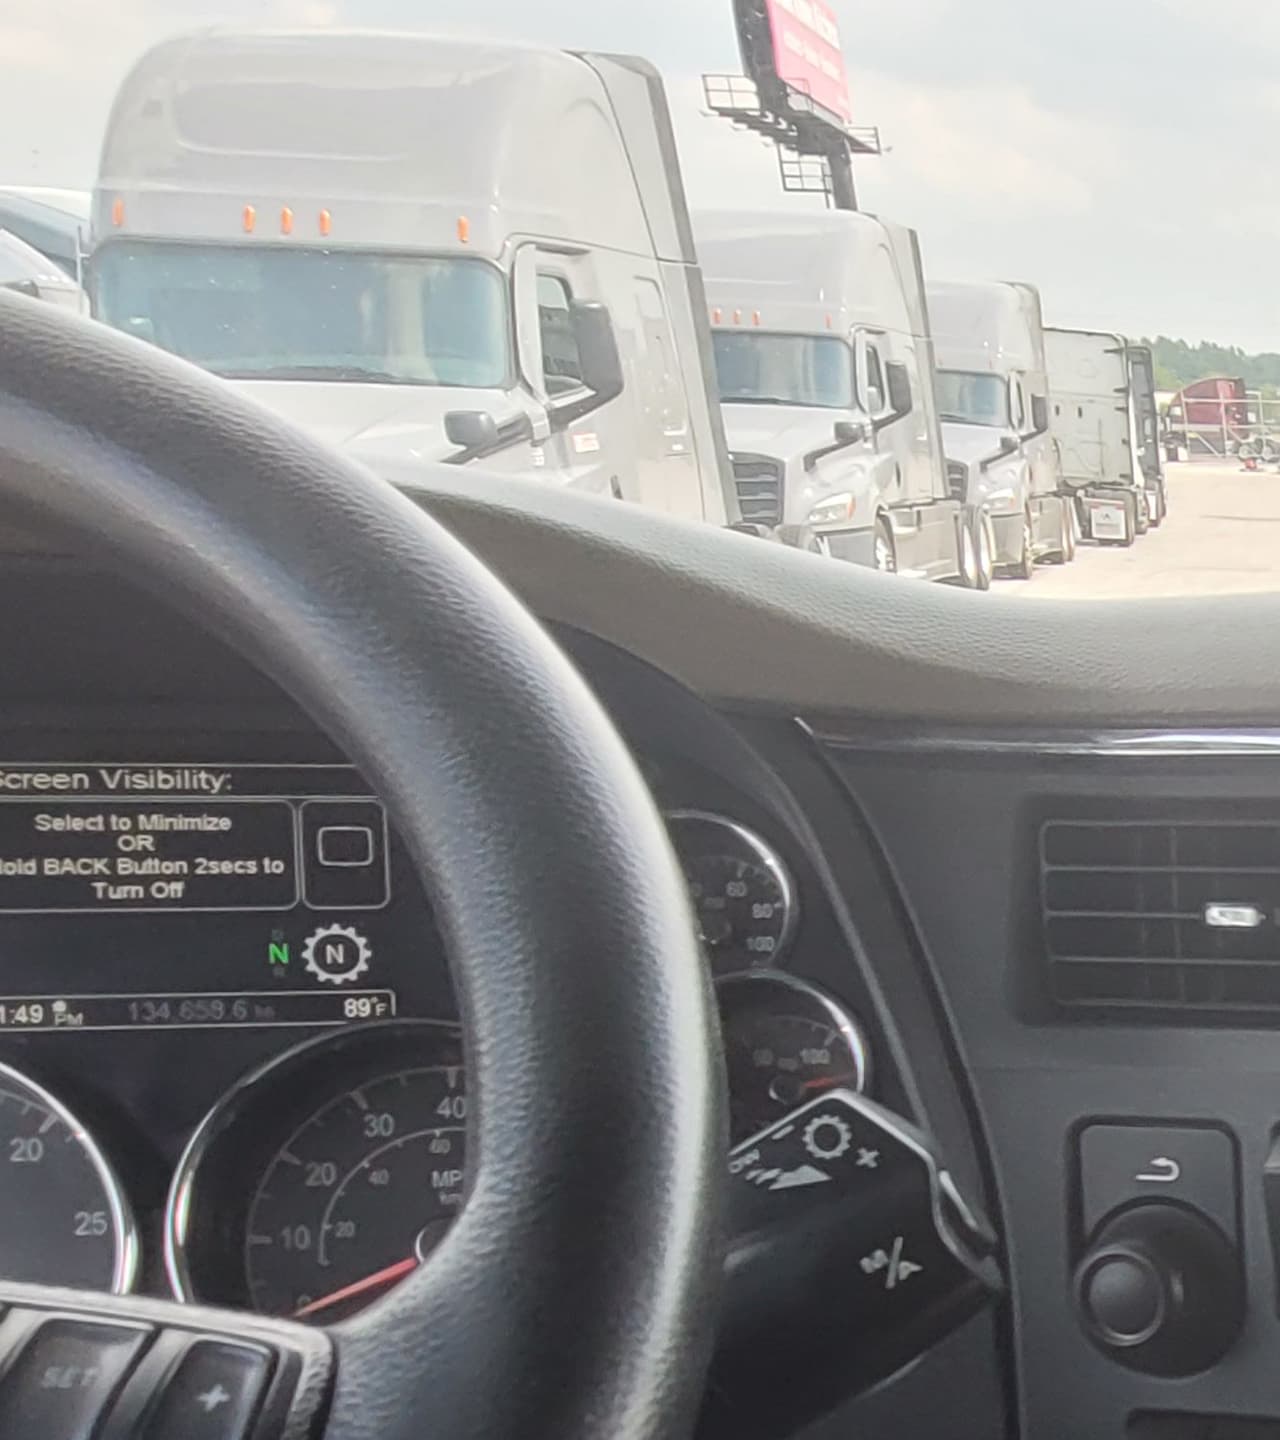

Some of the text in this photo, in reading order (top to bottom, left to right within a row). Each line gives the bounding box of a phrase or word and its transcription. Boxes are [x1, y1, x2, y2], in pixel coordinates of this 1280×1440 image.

[99, 769, 232, 794] Visibility:
[34, 814, 232, 832] Select to Minimize
[117, 834, 156, 852] OR
[0, 857, 285, 876] old BACK Button 2secs to
[90, 882, 185, 899] Turn Off
[269, 943, 344, 965] N N
[436, 1095, 465, 1118] 40
[363, 1113, 394, 1137] 30
[9, 1137, 43, 1162] 20
[305, 1162, 337, 1186] 20
[430, 1169, 463, 1187] MP
[74, 1211, 107, 1236] 25
[280, 1225, 311, 1249] 10
